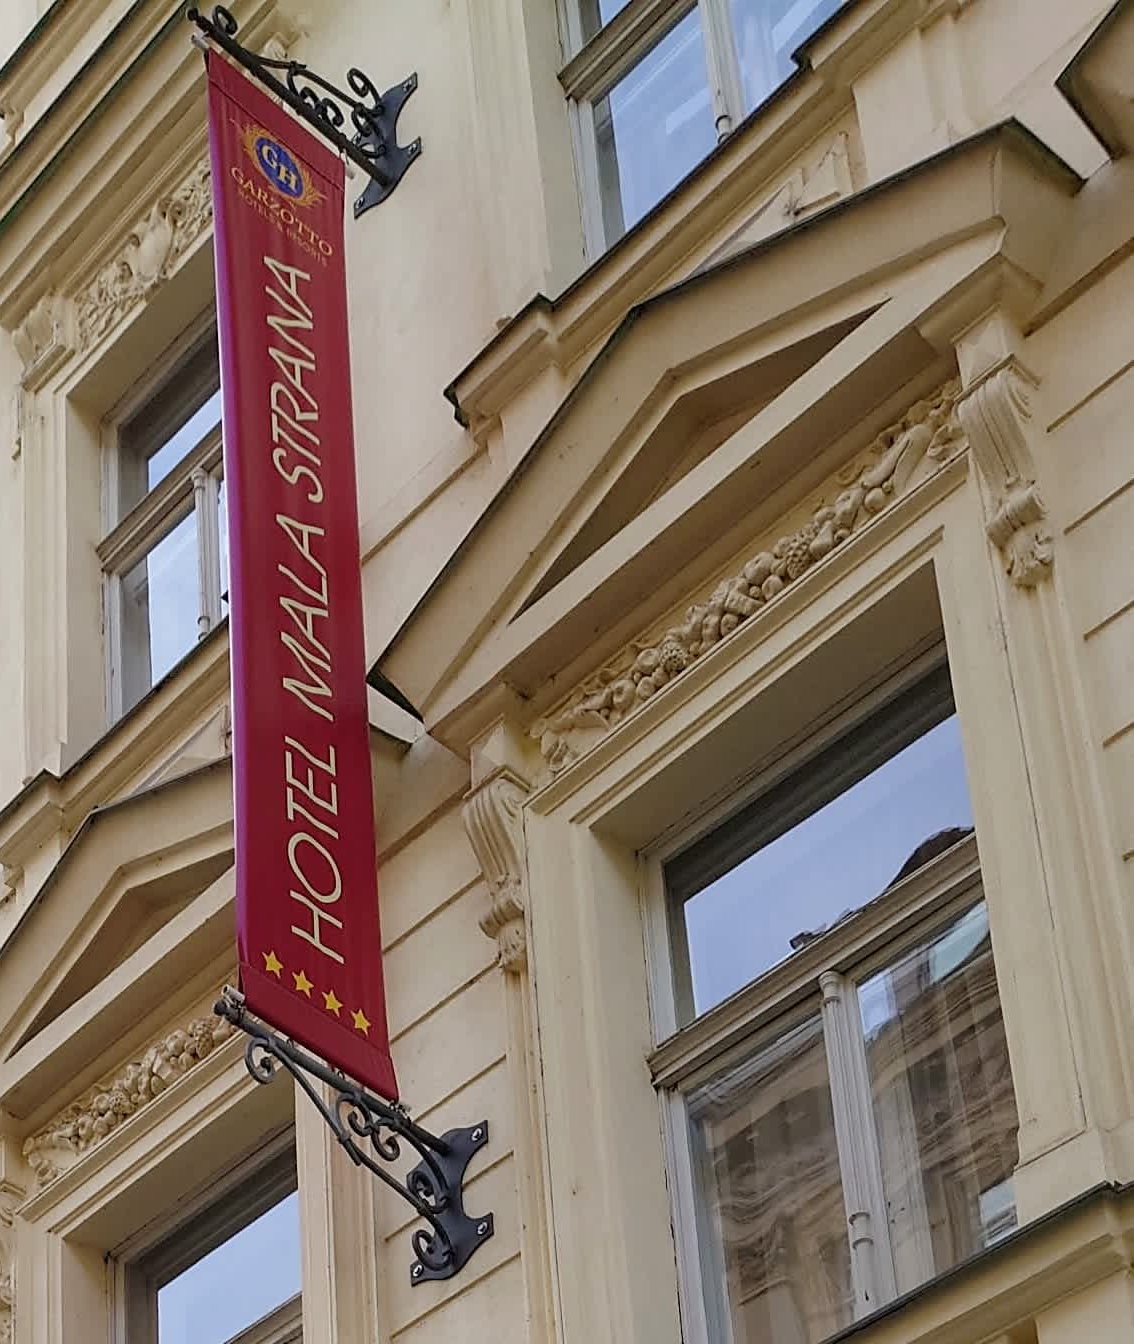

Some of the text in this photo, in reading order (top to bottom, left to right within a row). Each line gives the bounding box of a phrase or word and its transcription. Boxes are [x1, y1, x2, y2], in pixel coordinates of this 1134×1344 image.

[231, 168, 332, 256] GARZOTTO
[264, 256, 344, 964] HOTEL MALA STRANA
